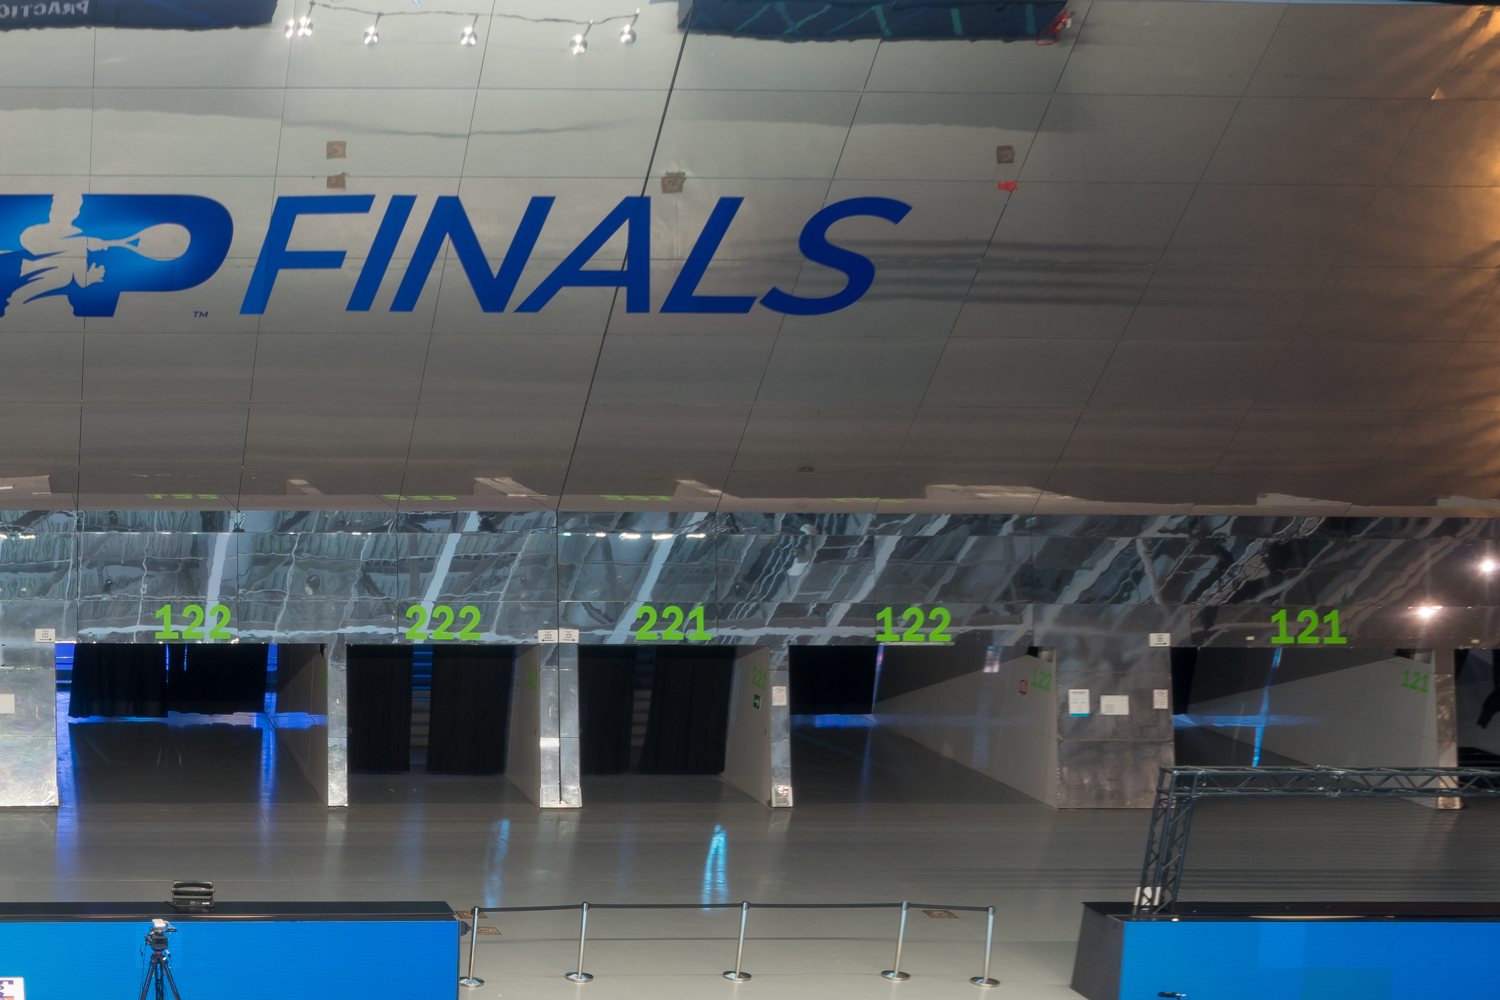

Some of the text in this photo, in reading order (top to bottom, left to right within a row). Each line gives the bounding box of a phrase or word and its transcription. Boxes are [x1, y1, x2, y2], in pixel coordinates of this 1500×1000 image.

[240, 195, 913, 316] FINALS
[154, 604, 231, 640] 122
[405, 604, 482, 641] 222
[635, 604, 713, 641] 221
[875, 606, 952, 642] 122
[1271, 608, 1348, 644] 121
[1031, 668, 1053, 692] 122
[1400, 669, 1429, 694] 121
